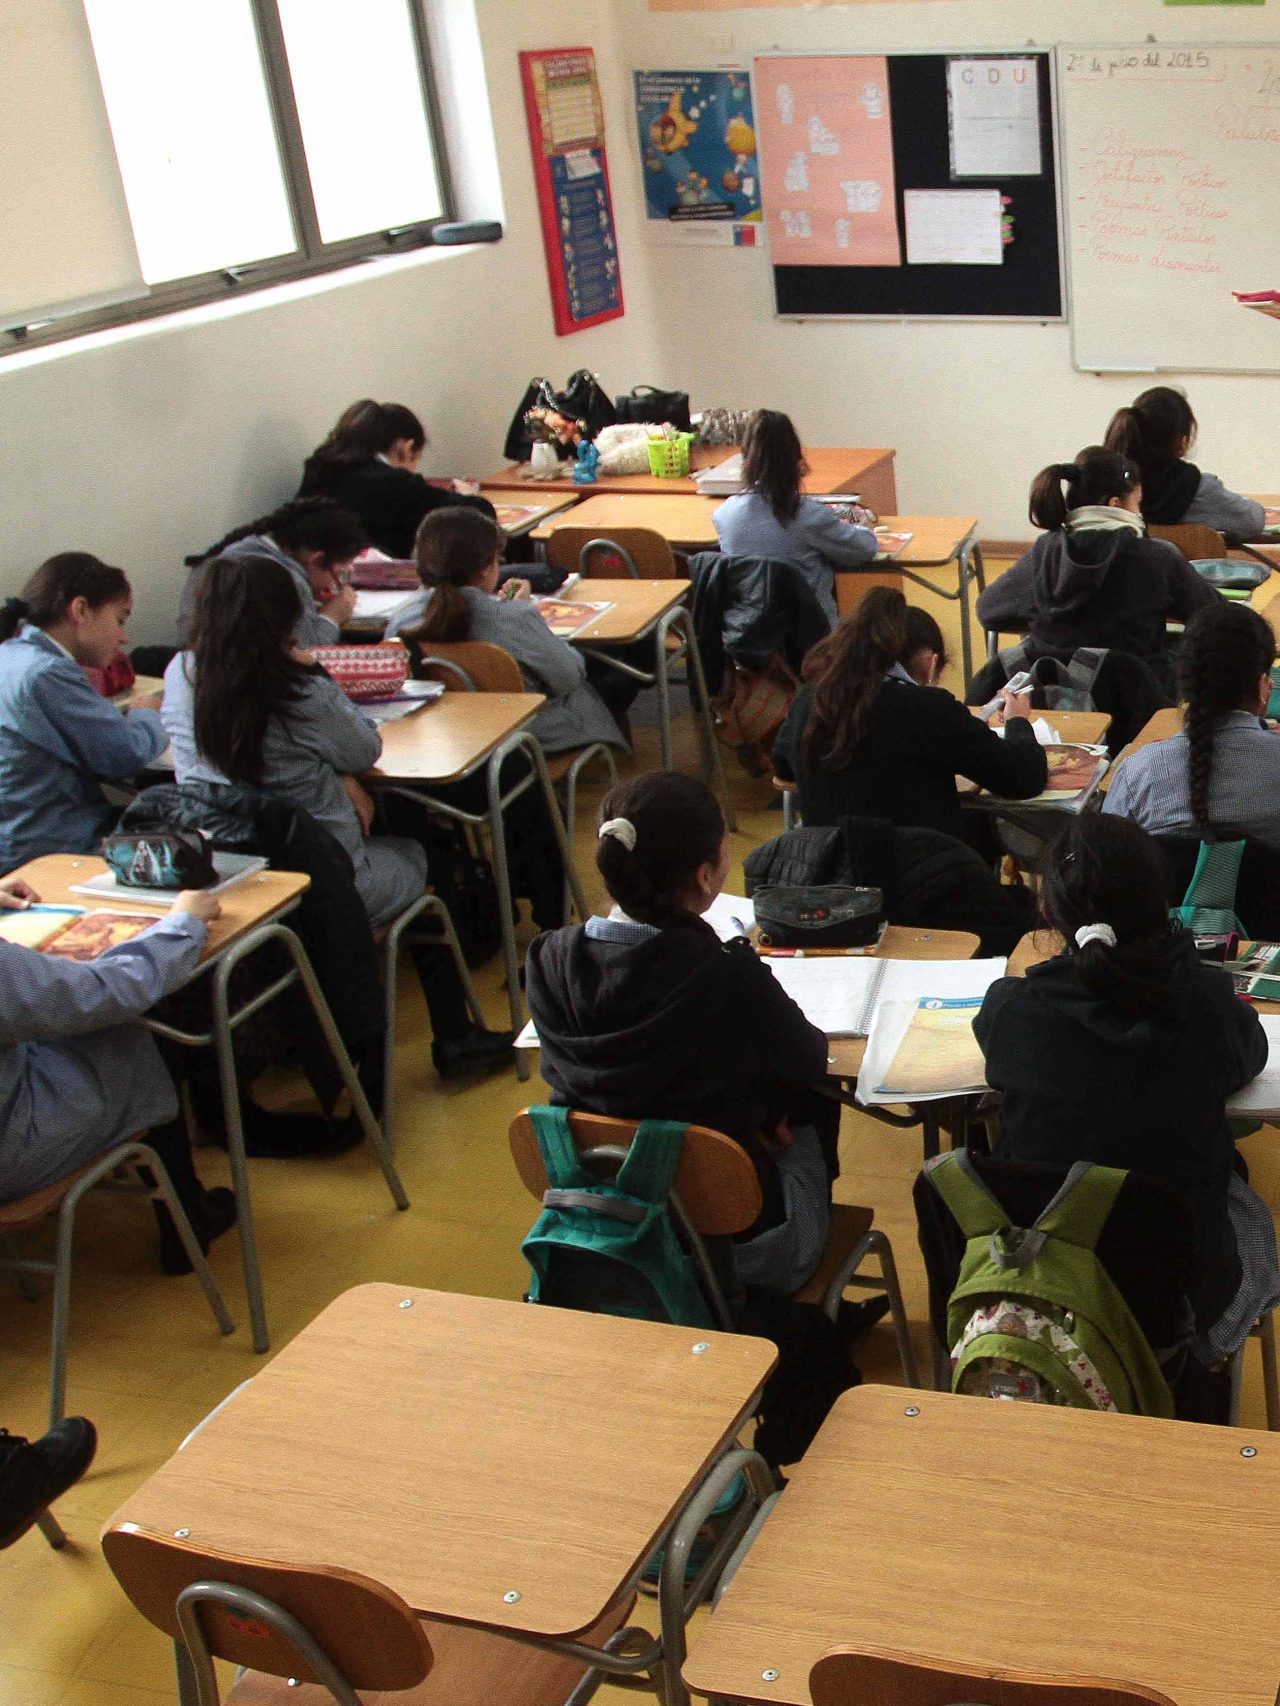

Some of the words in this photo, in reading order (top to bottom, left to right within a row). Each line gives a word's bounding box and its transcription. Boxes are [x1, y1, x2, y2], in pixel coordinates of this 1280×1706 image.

[1166, 51, 1209, 68] 2015
[961, 68, 974, 84] C
[1013, 68, 1027, 83] U
